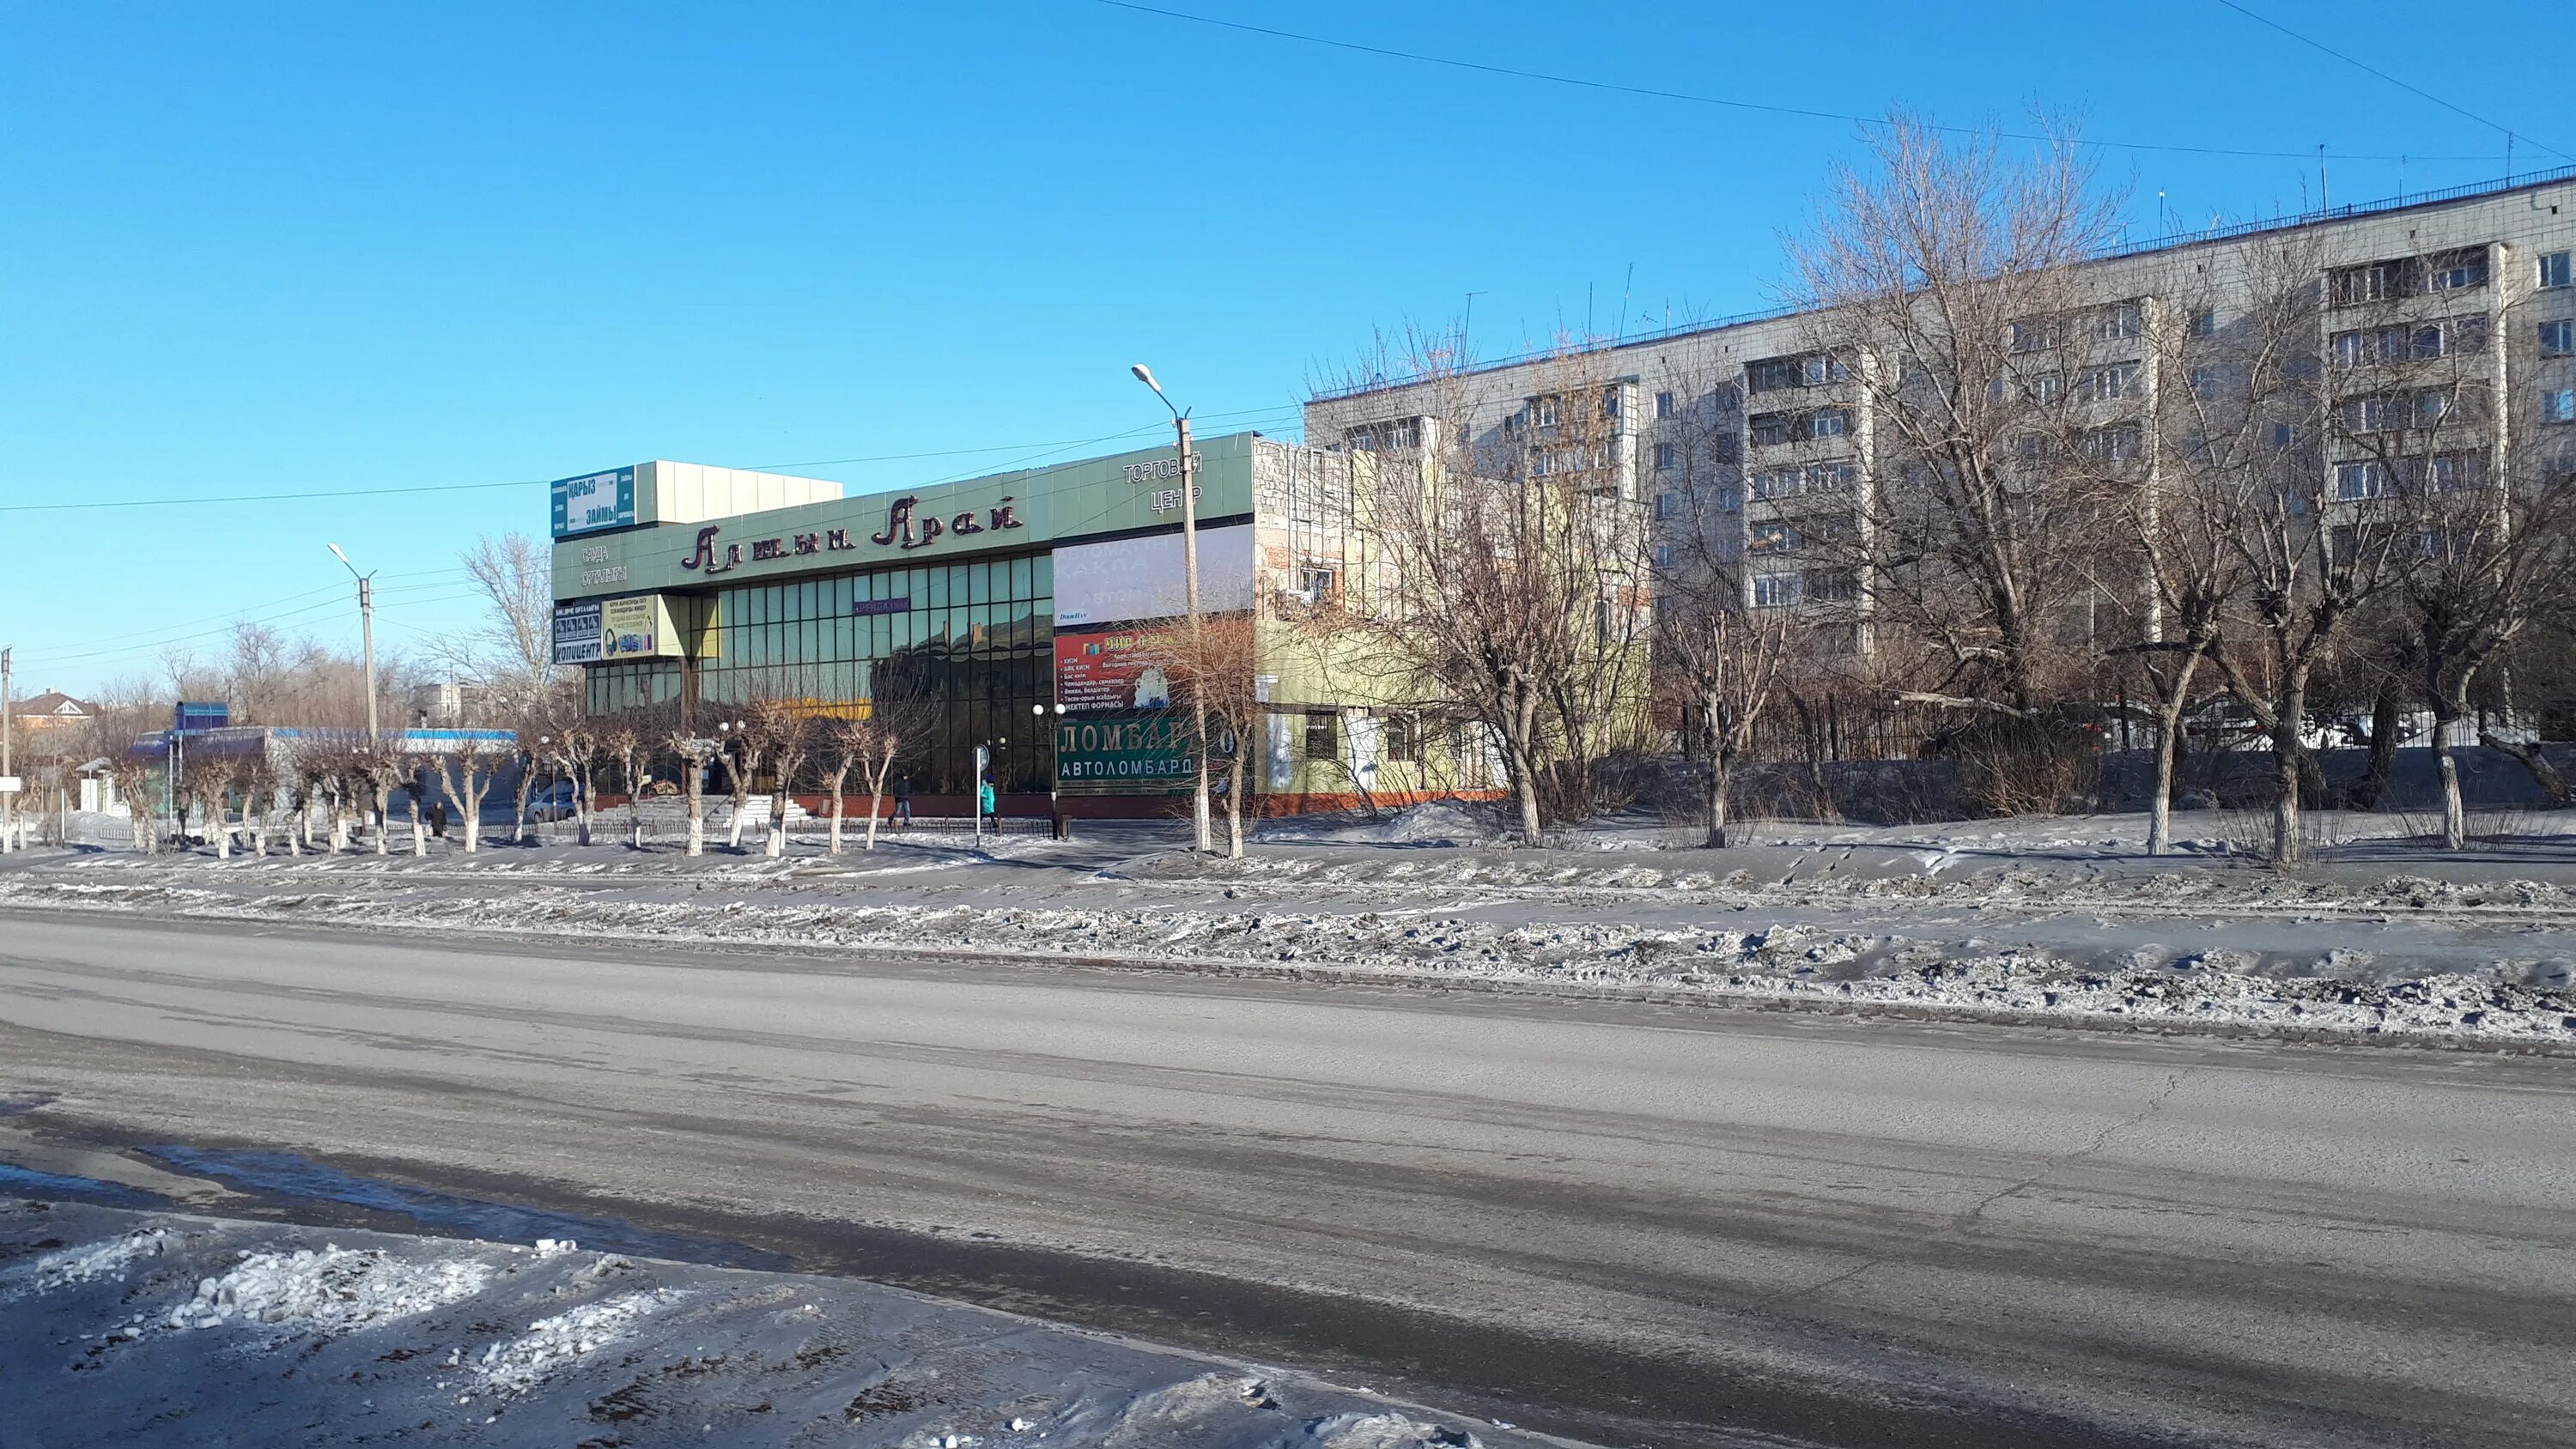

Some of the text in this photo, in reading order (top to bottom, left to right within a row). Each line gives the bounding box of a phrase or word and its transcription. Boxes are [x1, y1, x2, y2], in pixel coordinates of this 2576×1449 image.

[568, 479, 596, 500] ҚАРЫЗ
[1151, 486, 1202, 513] ЦЕНР
[586, 505, 617, 525] ЗАЙМЫ
[583, 545, 609, 563] САУДА
[556, 642, 600, 663] КОПИЦЕНТР
[1091, 700, 1124, 709] ФОРМАСЫ
[1060, 721, 1194, 753] ЛОМБАР
[1061, 758, 1192, 777] АВТОЛОМБАРД
